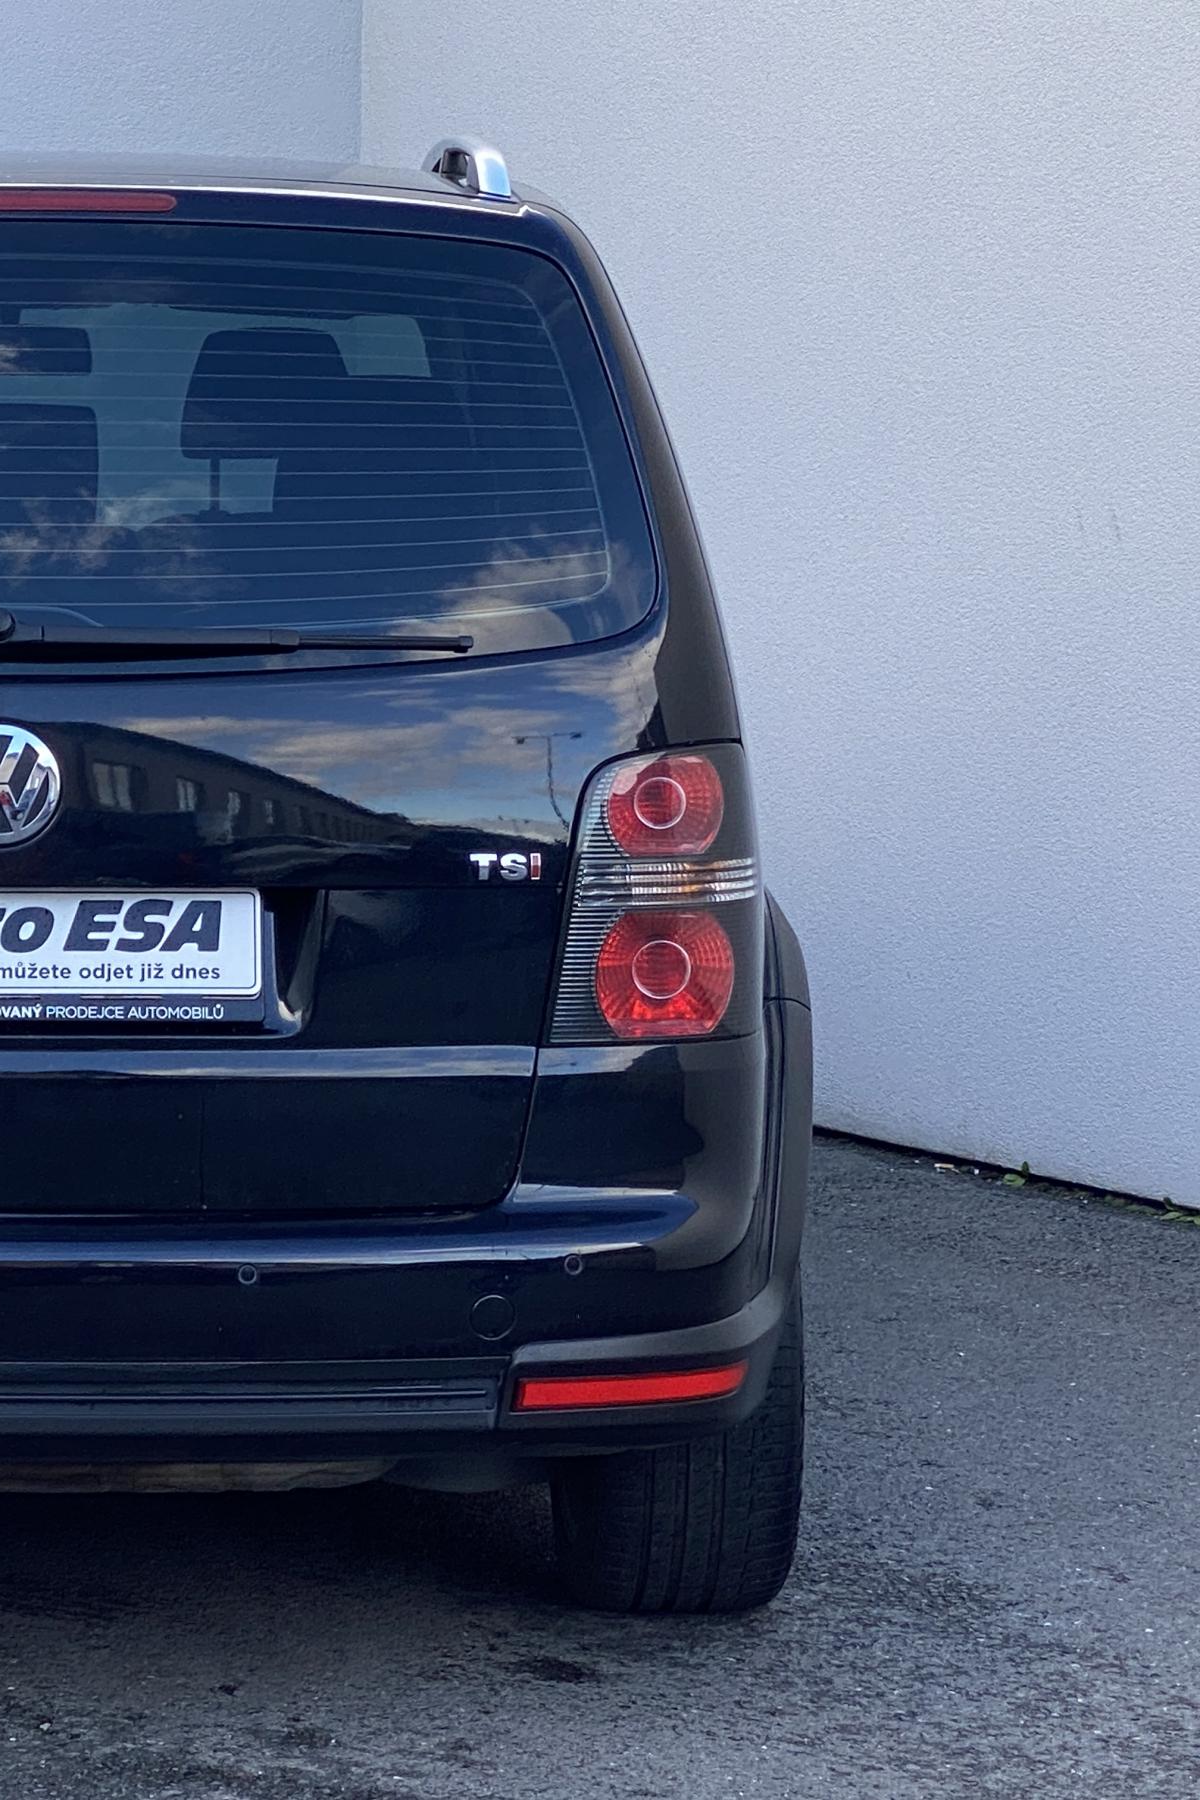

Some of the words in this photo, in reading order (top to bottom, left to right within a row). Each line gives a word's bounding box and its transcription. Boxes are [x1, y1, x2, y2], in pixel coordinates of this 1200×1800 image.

[468, 852, 542, 881] TSI
[63, 898, 222, 953] ESA
[79, 964, 133, 982] odjet
[139, 963, 163, 982] již
[171, 963, 221, 980] dnes
[46, 1006, 125, 1019] PRODEJCE
[127, 1003, 224, 1019] AUTOMOBILŮ
